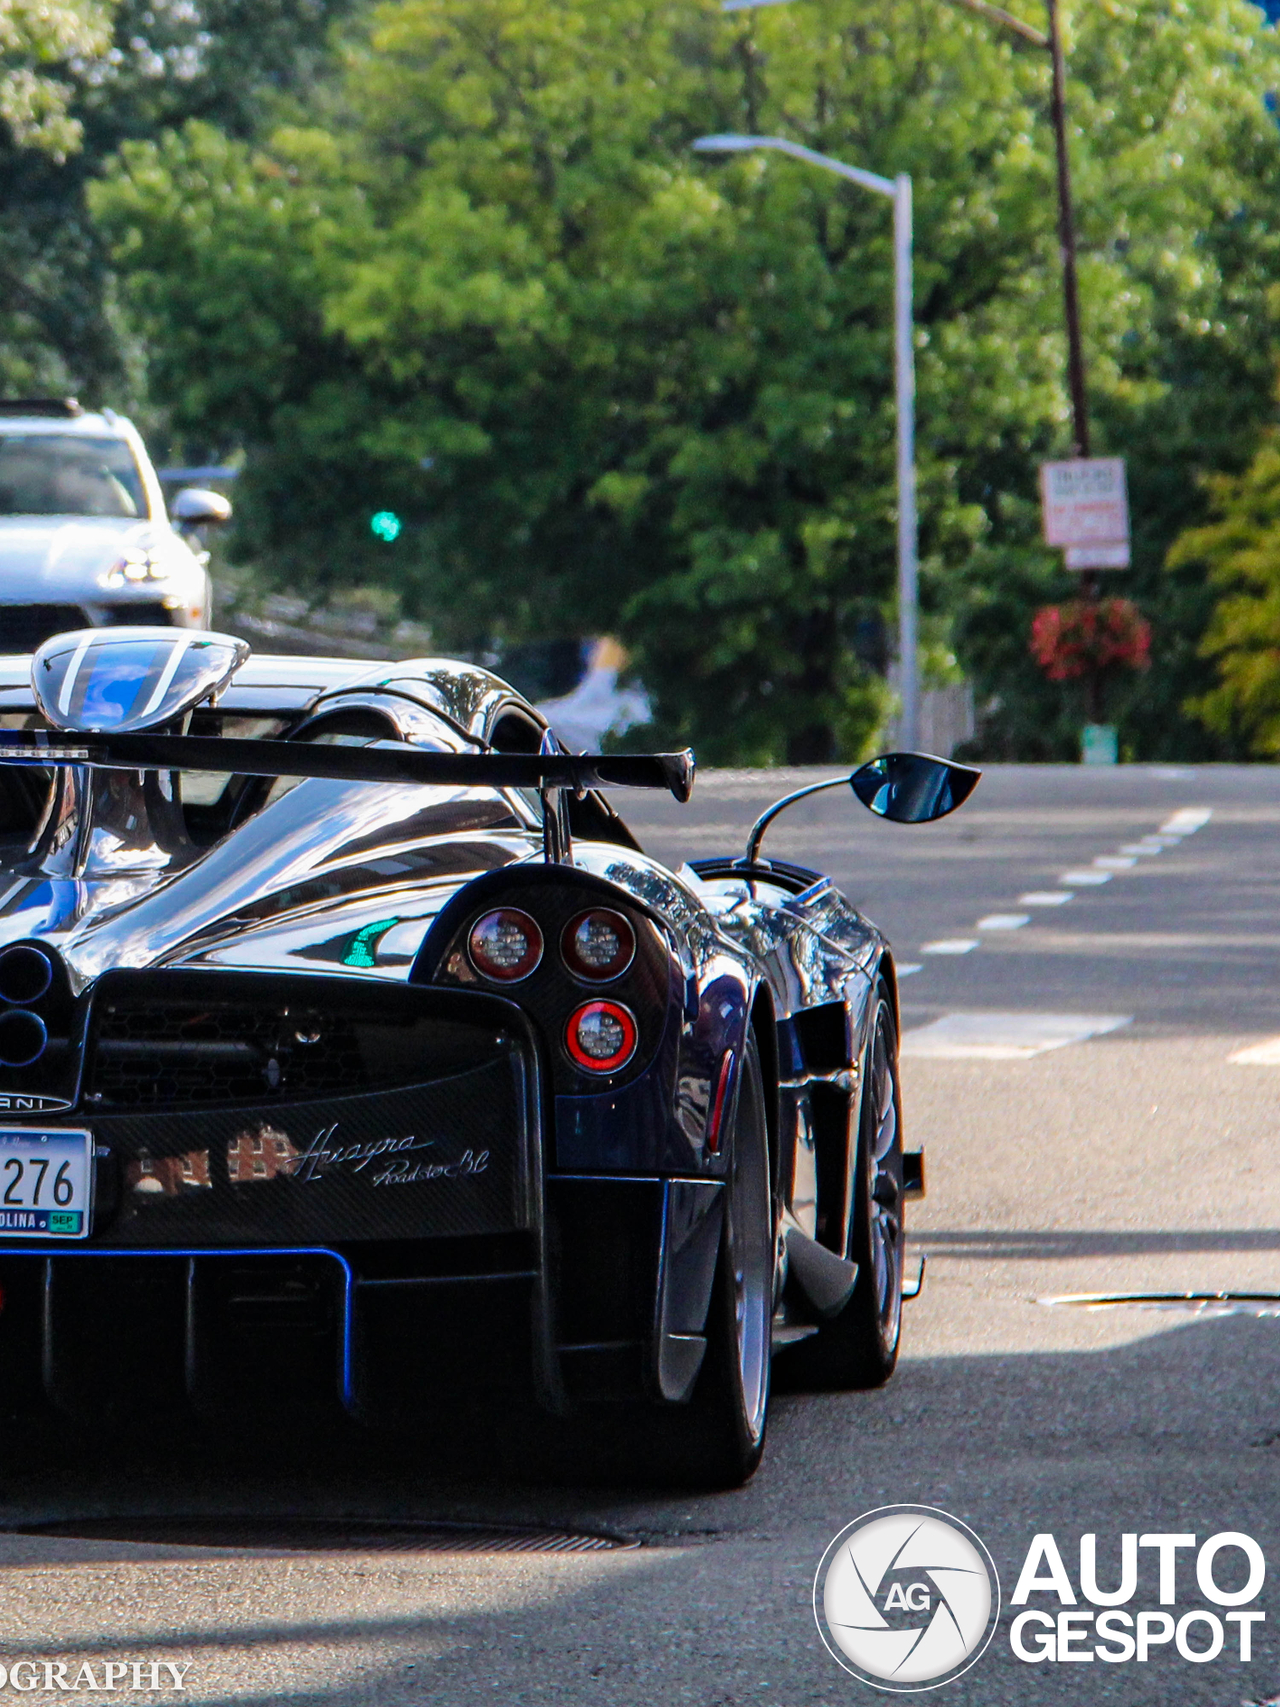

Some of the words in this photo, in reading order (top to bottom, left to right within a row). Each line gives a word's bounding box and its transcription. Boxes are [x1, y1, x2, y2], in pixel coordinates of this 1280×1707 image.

[284, 1122, 434, 1184] Huayra
[373, 1159, 458, 1188] Roadster
[459, 1149, 490, 1175] BC
[3, 1158, 74, 1207] 276
[52, 1215, 73, 1225] SEP
